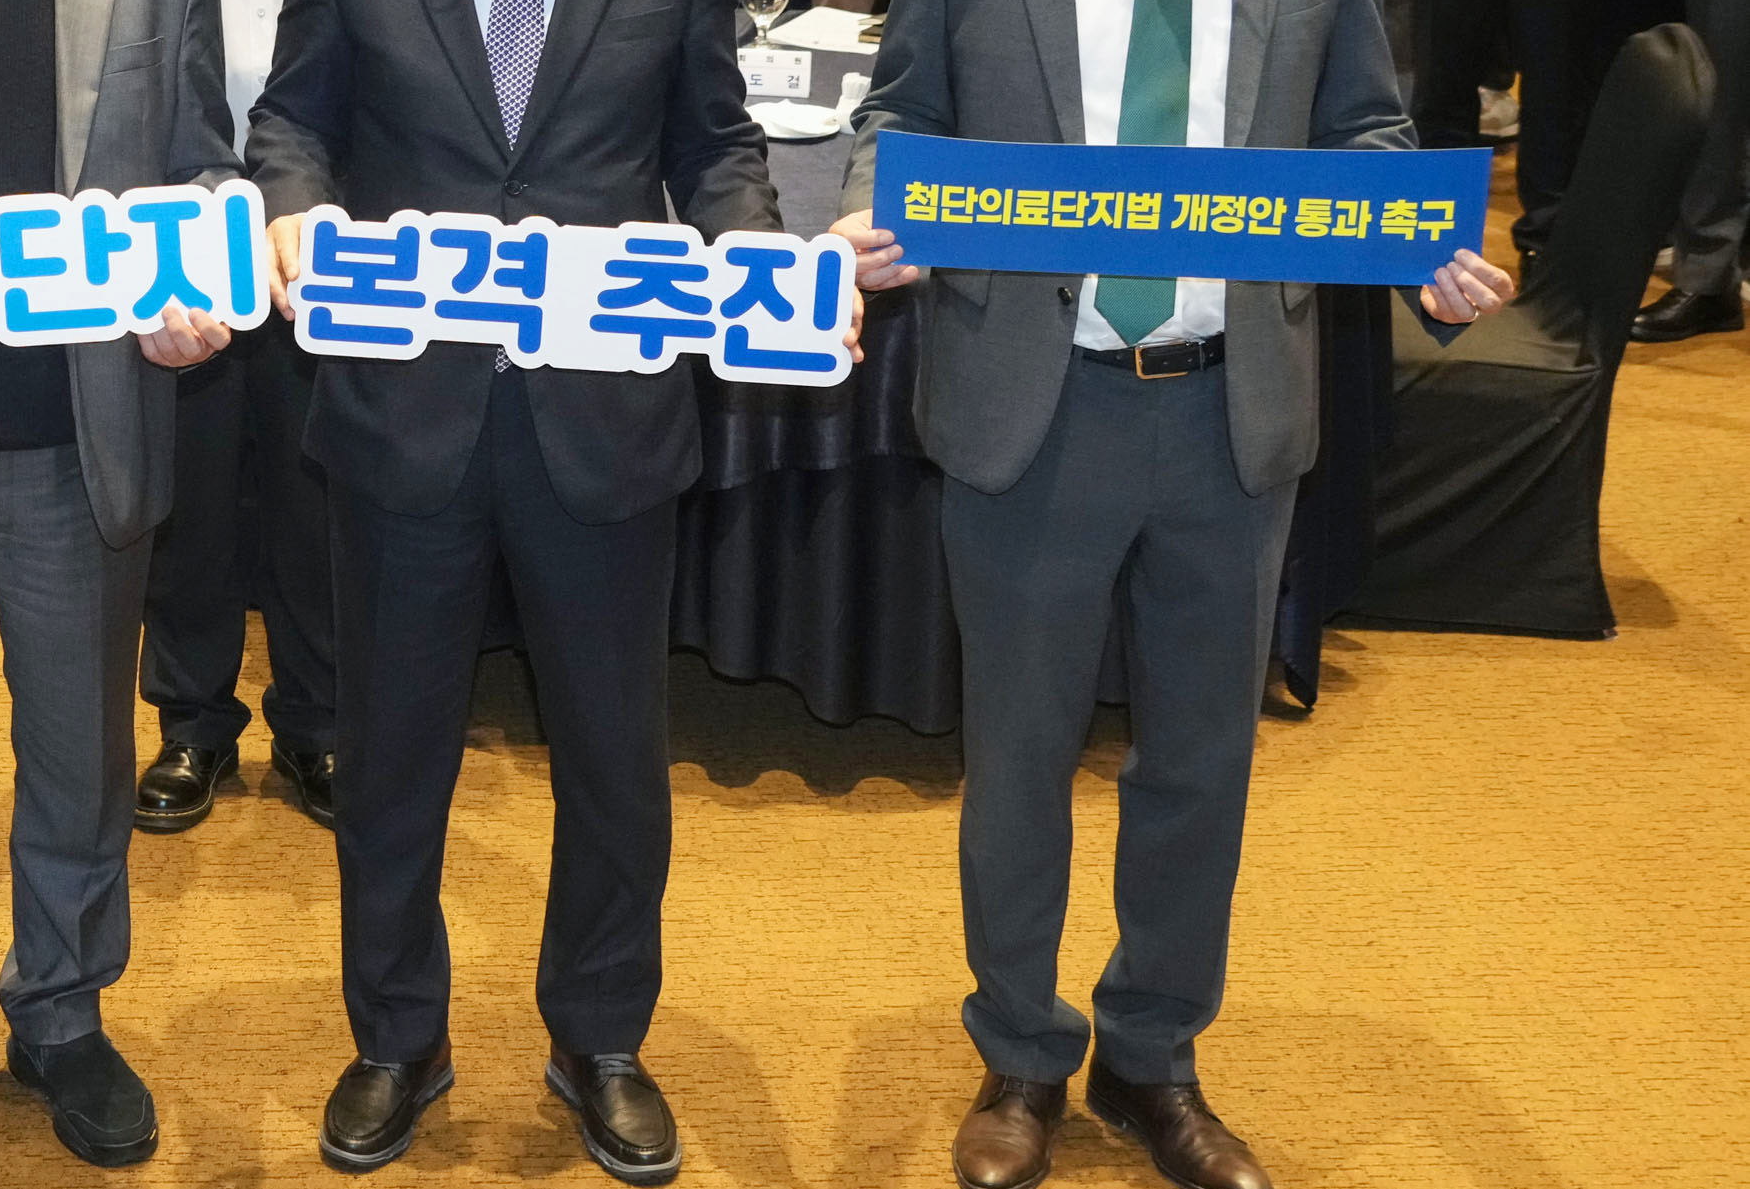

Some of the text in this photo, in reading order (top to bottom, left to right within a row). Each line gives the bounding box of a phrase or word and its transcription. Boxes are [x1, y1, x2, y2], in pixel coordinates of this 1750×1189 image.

[904, 182, 1454, 242] 첨단의료단지법 개정안 통과 촉구
[300, 220, 841, 373] 본격 추진
